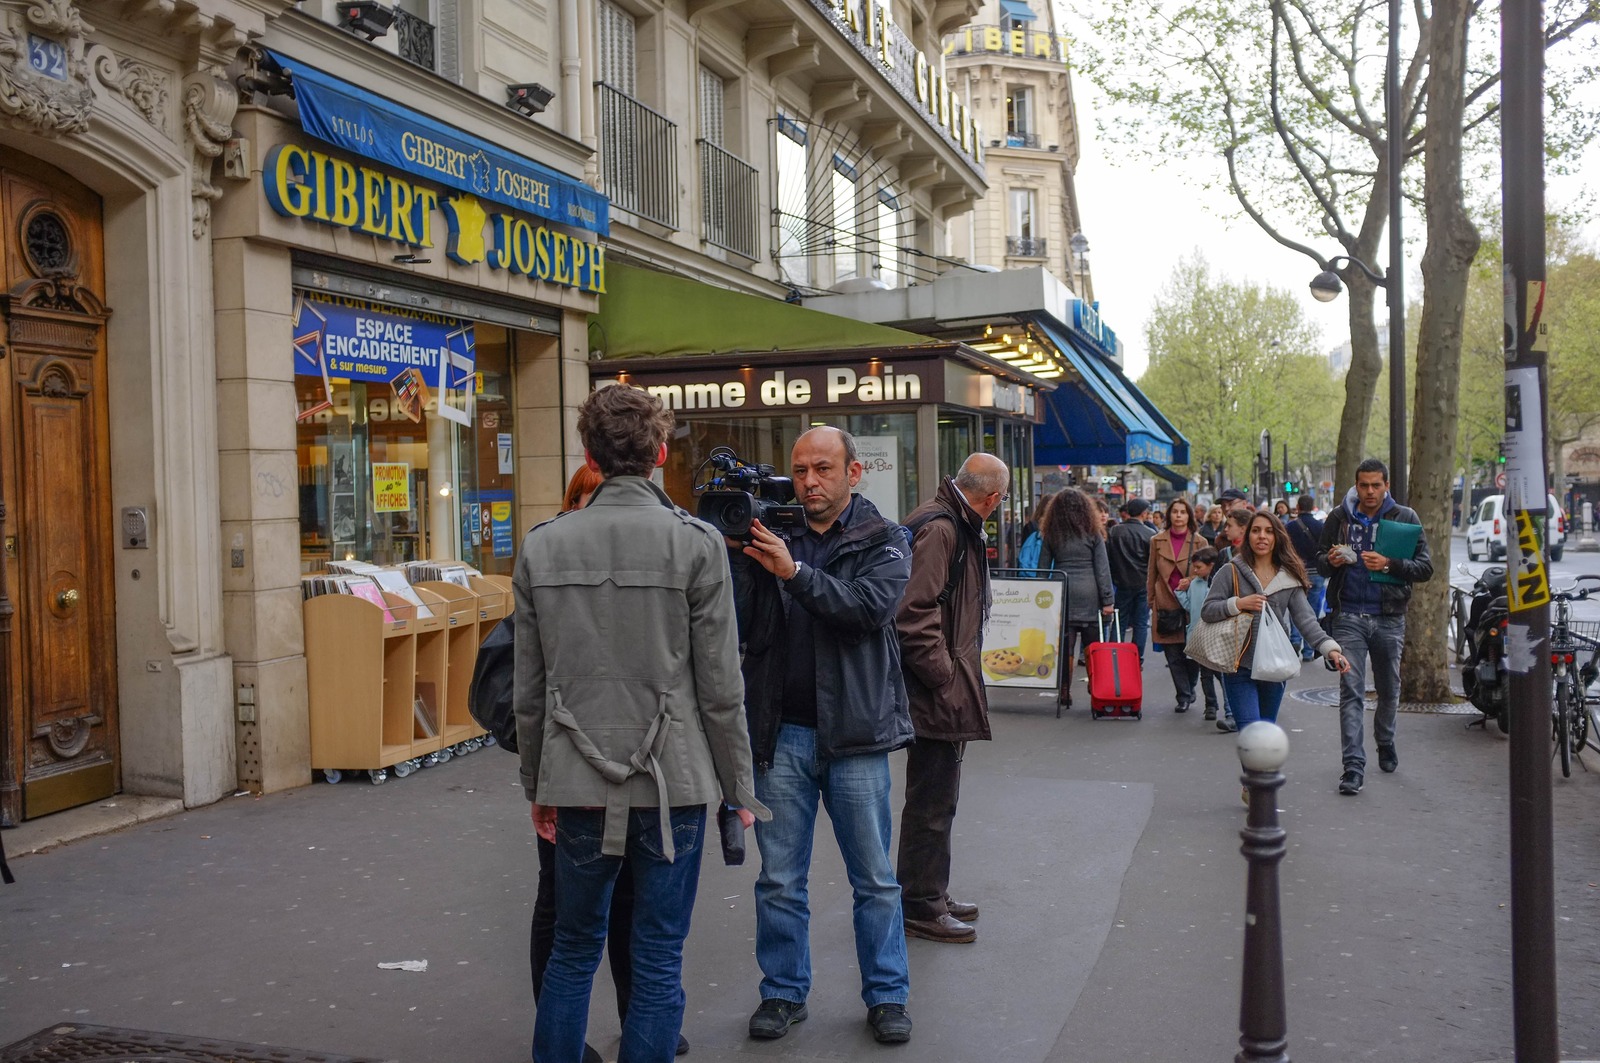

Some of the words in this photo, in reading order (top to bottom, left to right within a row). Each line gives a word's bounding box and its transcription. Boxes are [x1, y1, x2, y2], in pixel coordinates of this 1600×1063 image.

[31, 36, 64, 76] 32
[944, 26, 1073, 58] IBERT
[914, 51, 981, 163] GIBERT
[331, 115, 374, 146] STYLOS
[401, 131, 468, 180] GIBERT
[494, 168, 552, 209] JOSEPH
[268, 143, 438, 249] GIBERT
[490, 213, 608, 295] JOSEPH
[355, 316, 413, 345] ESPACE
[325, 334, 439, 368] ENCADREMENT
[330, 358, 338, 369] &
[339, 361, 354, 373] sur
[355, 362, 388, 376] mesure
[596, 378, 746, 410] mme
[760, 370, 811, 406] de
[827, 365, 921, 403] Pain
[375, 465, 407, 481] PROMOTION
[874, 458, 893, 472] Bio
[376, 493, 408, 508] AFFICHES
[991, 593, 1032, 605] urmand
[1005, 587, 1020, 596] duo
